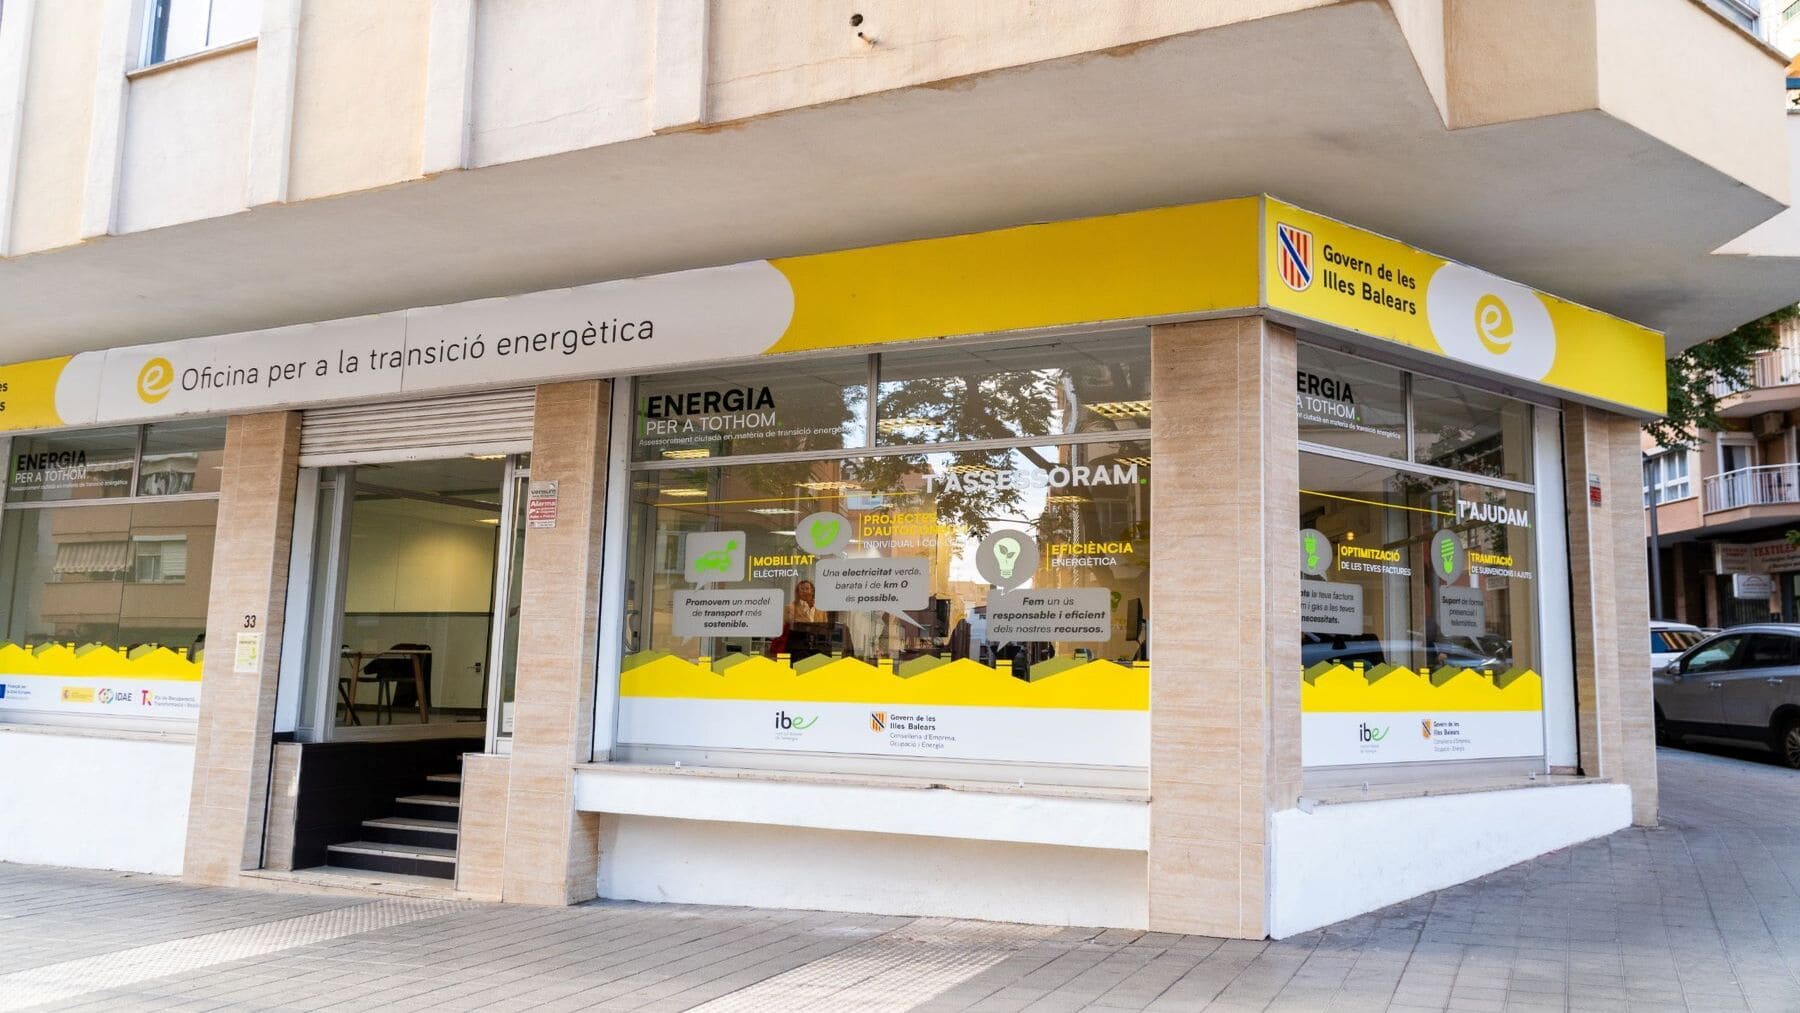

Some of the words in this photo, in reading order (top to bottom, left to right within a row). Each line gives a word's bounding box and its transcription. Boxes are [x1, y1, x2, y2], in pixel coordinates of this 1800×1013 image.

[1323, 245, 1372, 276] Govern
[1377, 264, 1393, 281] de
[1397, 268, 1416, 289] les
[1323, 269, 1356, 296] Illes
[1362, 282, 1417, 316] Balears
[182, 366, 258, 391] Oficina
[268, 361, 307, 388] per
[316, 359, 328, 376] a
[338, 349, 359, 374] la
[370, 335, 485, 371] transició
[497, 318, 655, 356] energètica
[647, 386, 775, 419] ENERGIA
[646, 419, 678, 435] PER
[682, 419, 695, 433] A
[766, 426, 776, 437] de
[17, 450, 87, 471] ENERGIA
[15, 471, 33, 484] PER
[35, 471, 42, 482] A
[1052, 541, 1133, 556] EFICIÈNCIA
[1340, 545, 1400, 562] OPTIMITZACIÓ
[754, 554, 815, 567] MOBILITAT
[1052, 556, 1116, 567] ENERGÈTICA
[1471, 551, 1513, 567] TRAMITACIÓ
[822, 568, 839, 577] Una
[842, 567, 892, 577] electricitat
[1341, 561, 1350, 569] DE
[1350, 562, 1361, 570] LES
[1363, 563, 1381, 573] TEVES
[1382, 566, 1411, 576] FACTURES
[835, 581, 863, 590] barata
[869, 580, 881, 589] de
[884, 580, 897, 589] km
[686, 598, 730, 607] Promovem
[732, 598, 742, 606] un
[744, 596, 771, 606] model
[858, 593, 898, 604] possible.
[1022, 597, 1045, 605] Fem
[1047, 597, 1060, 606] un
[692, 609, 703, 617] de
[704, 609, 744, 618] transport
[993, 610, 1056, 621] responsable
[1065, 610, 1106, 620] eficient
[244, 615, 256, 628] 33
[704, 620, 748, 628] sostenible.
[993, 623, 1013, 633] dels
[1016, 624, 1054, 633] nostres
[1054, 624, 1104, 634] recursos.
[115, 692, 132, 702] IDAE
[776, 710, 818, 729] ibe
[890, 714, 913, 722] Govern
[916, 714, 924, 722] de
[908, 723, 936, 731] Balears
[1360, 722, 1389, 742] ibe
